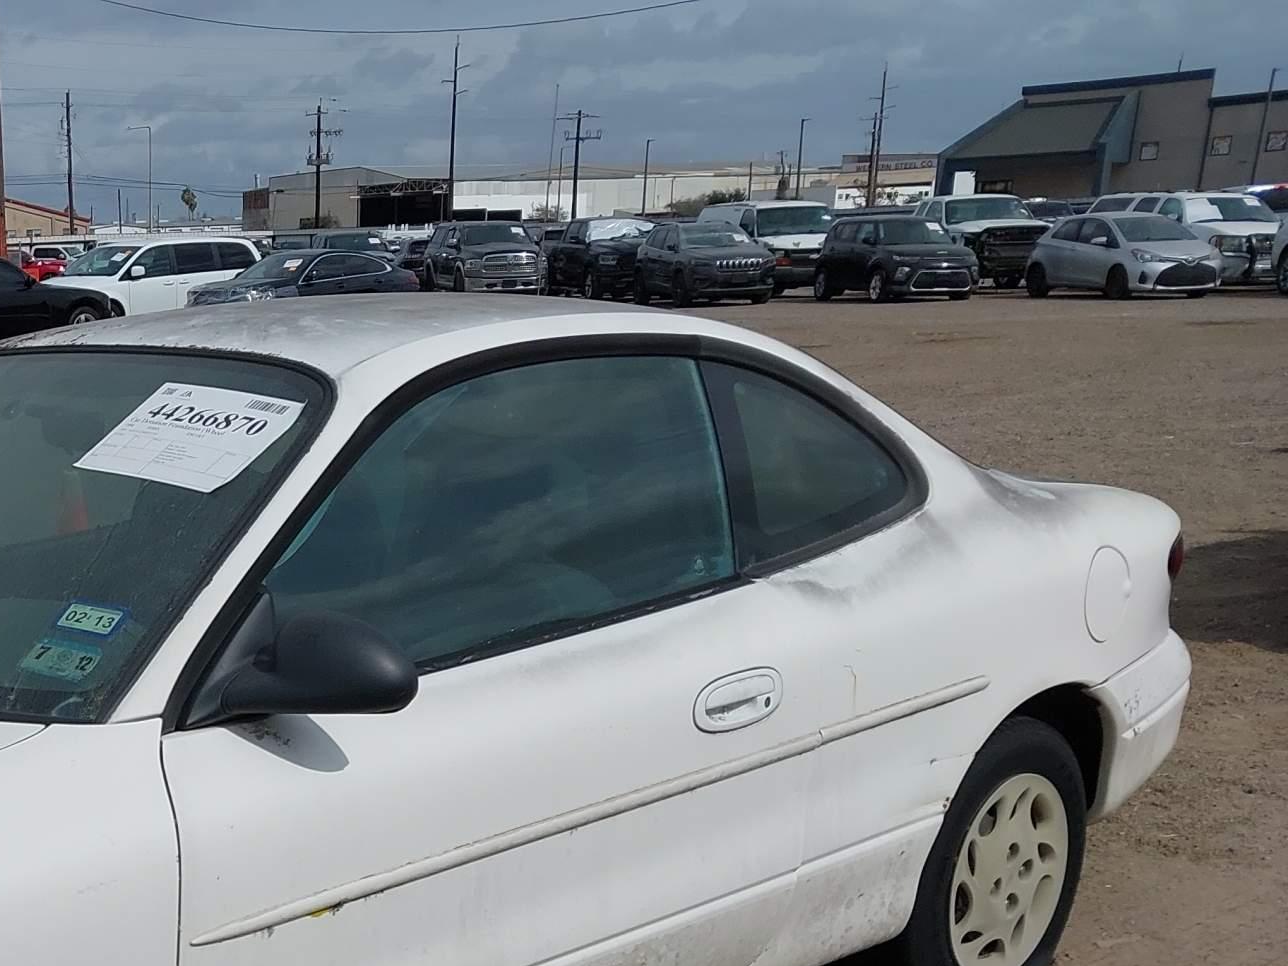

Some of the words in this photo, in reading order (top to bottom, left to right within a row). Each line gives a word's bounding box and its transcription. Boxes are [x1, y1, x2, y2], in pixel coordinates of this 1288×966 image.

[148, 402, 269, 436] 44266870
[34, 645, 52, 660] 7
[75, 655, 93, 671] 12
